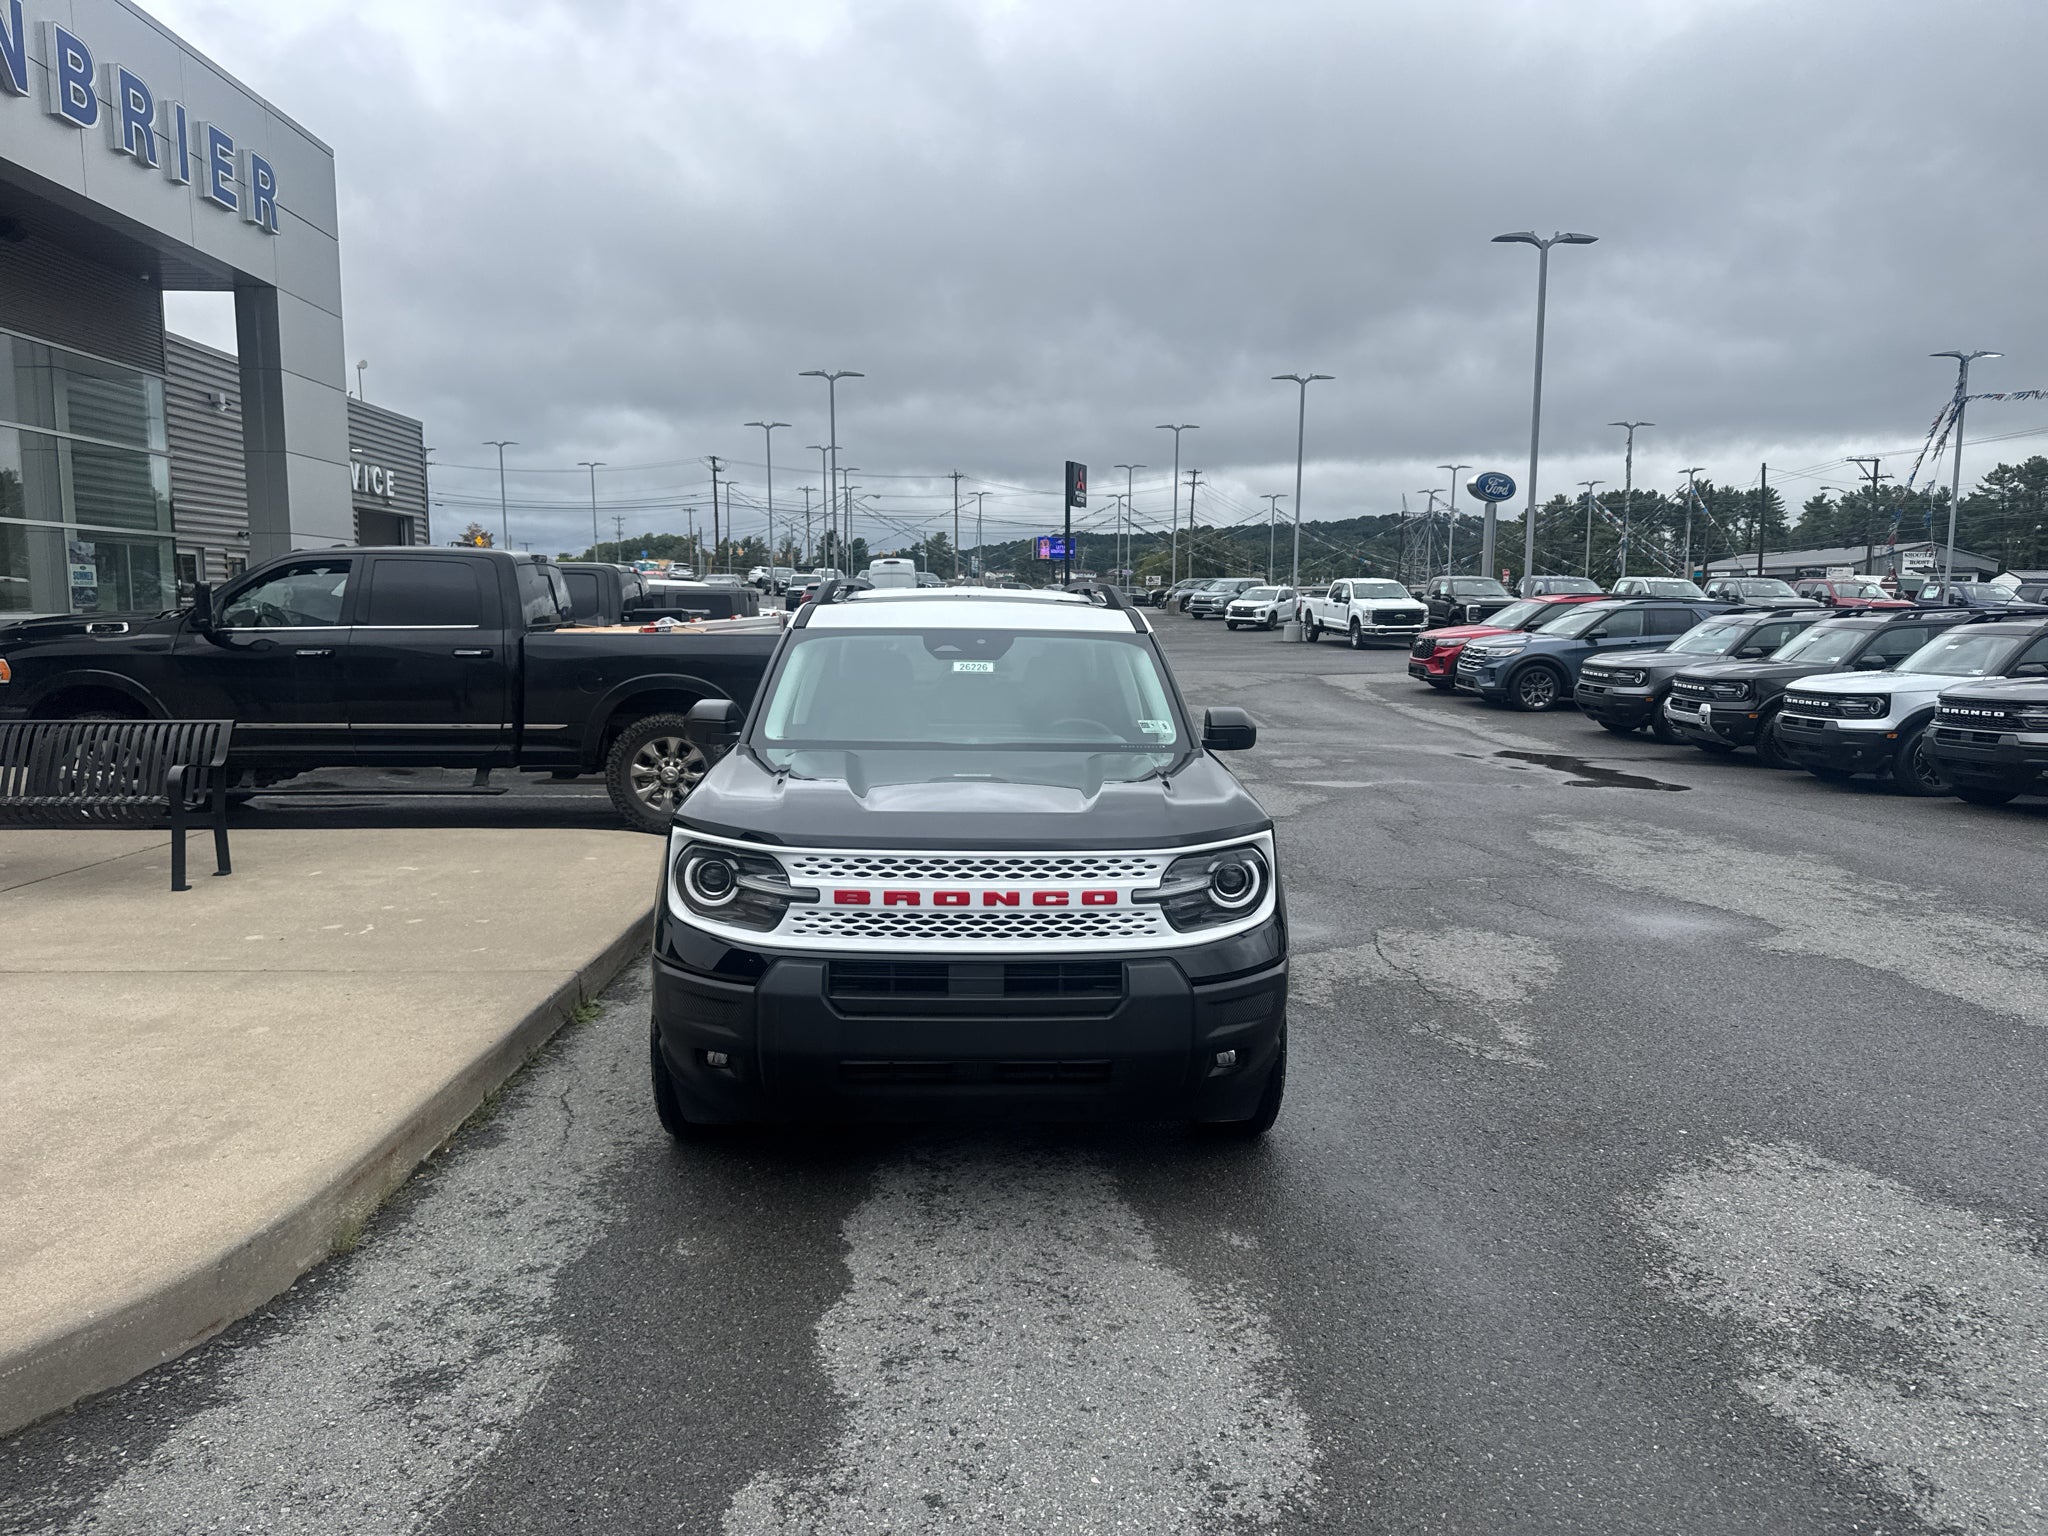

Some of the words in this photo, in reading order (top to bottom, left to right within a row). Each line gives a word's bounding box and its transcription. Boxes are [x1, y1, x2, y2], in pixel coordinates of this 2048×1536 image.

[1485, 476, 1510, 496] Ford
[959, 663, 988, 671] 26226
[1582, 670, 1609, 678] BRONCO
[1673, 682, 1705, 691] BRONCO
[1786, 698, 1830, 707] BRONCO
[1941, 707, 2005, 718] BRONCO
[833, 889, 1118, 906] BRONCO
